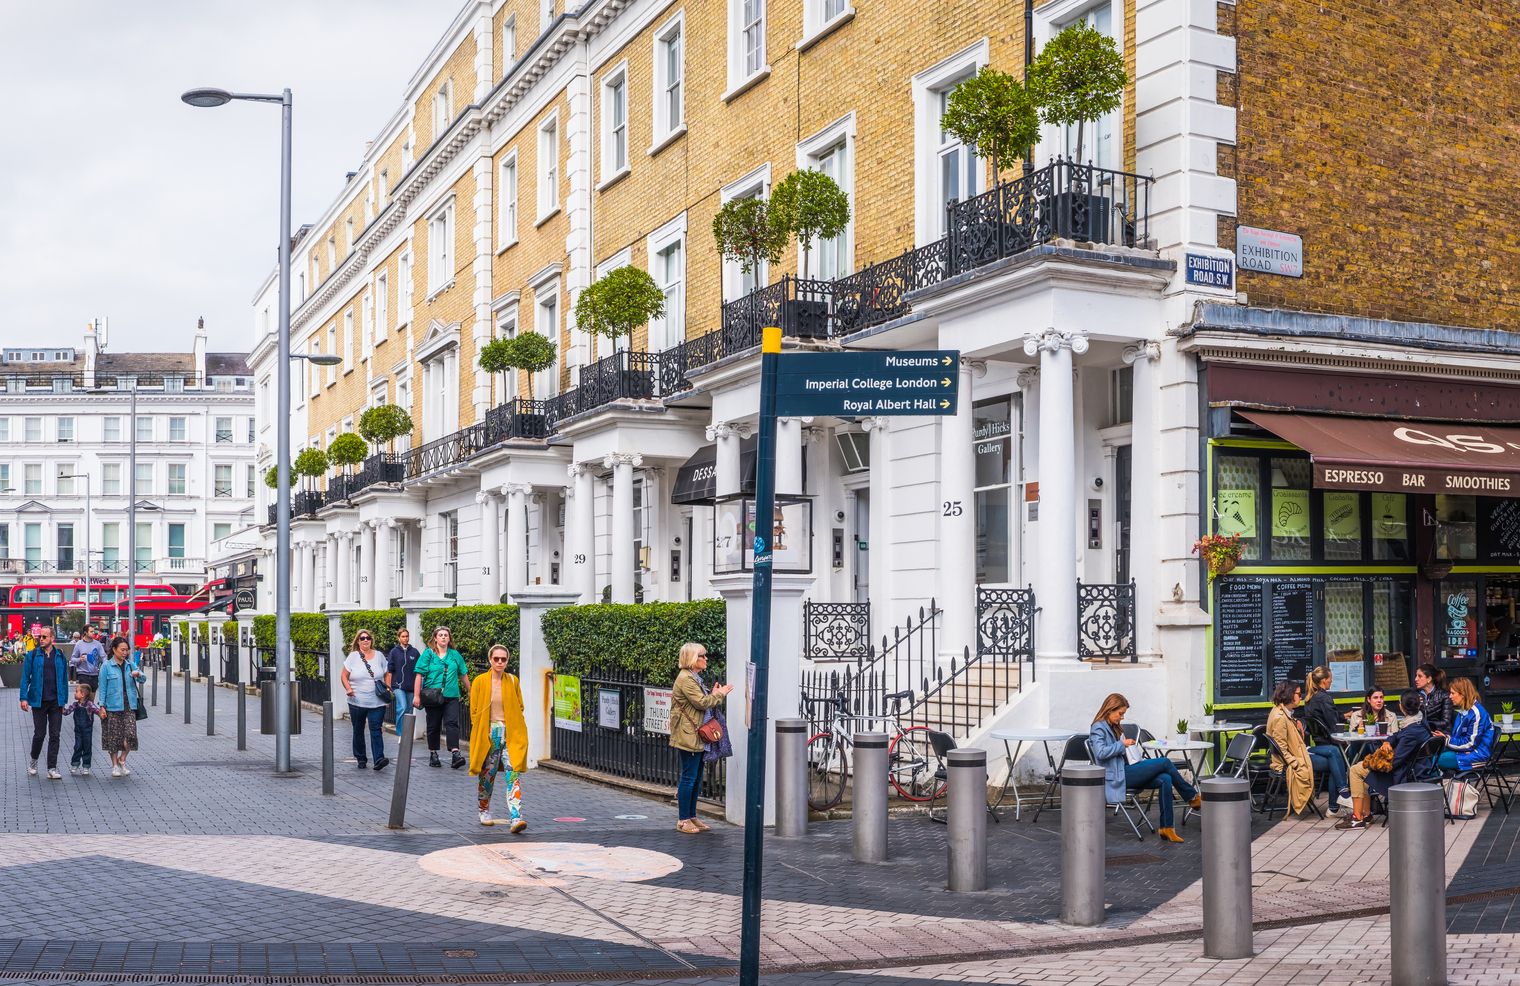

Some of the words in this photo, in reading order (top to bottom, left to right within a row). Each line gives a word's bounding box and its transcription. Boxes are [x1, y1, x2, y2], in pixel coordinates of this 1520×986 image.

[1242, 245, 1298, 262] EXHIBITION
[1189, 256, 1230, 273] EXHIBITION
[1280, 263, 1298, 273] SW7
[1216, 274, 1229, 285] S.W.
[885, 356, 938, 367] Museums
[805, 379, 849, 390] Imperial
[851, 378, 892, 390] College
[895, 377, 937, 388] London
[843, 400, 873, 412] Royal
[875, 399, 911, 410] Albert
[913, 399, 937, 409] Hall
[991, 422, 1010, 434] Hicks
[978, 443, 1001, 454] Gallery
[1324, 469, 1384, 485] ESPRESSO
[1402, 473, 1425, 487] BAR
[1445, 475, 1511, 491] SMOOTHIES
[943, 501, 963, 517] 25
[574, 553, 586, 564] 29
[482, 566, 491, 575] 31
[1447, 593, 1470, 608] Coffee
[1448, 637, 1468, 645] IDEA
[645, 718, 663, 729] STREET
